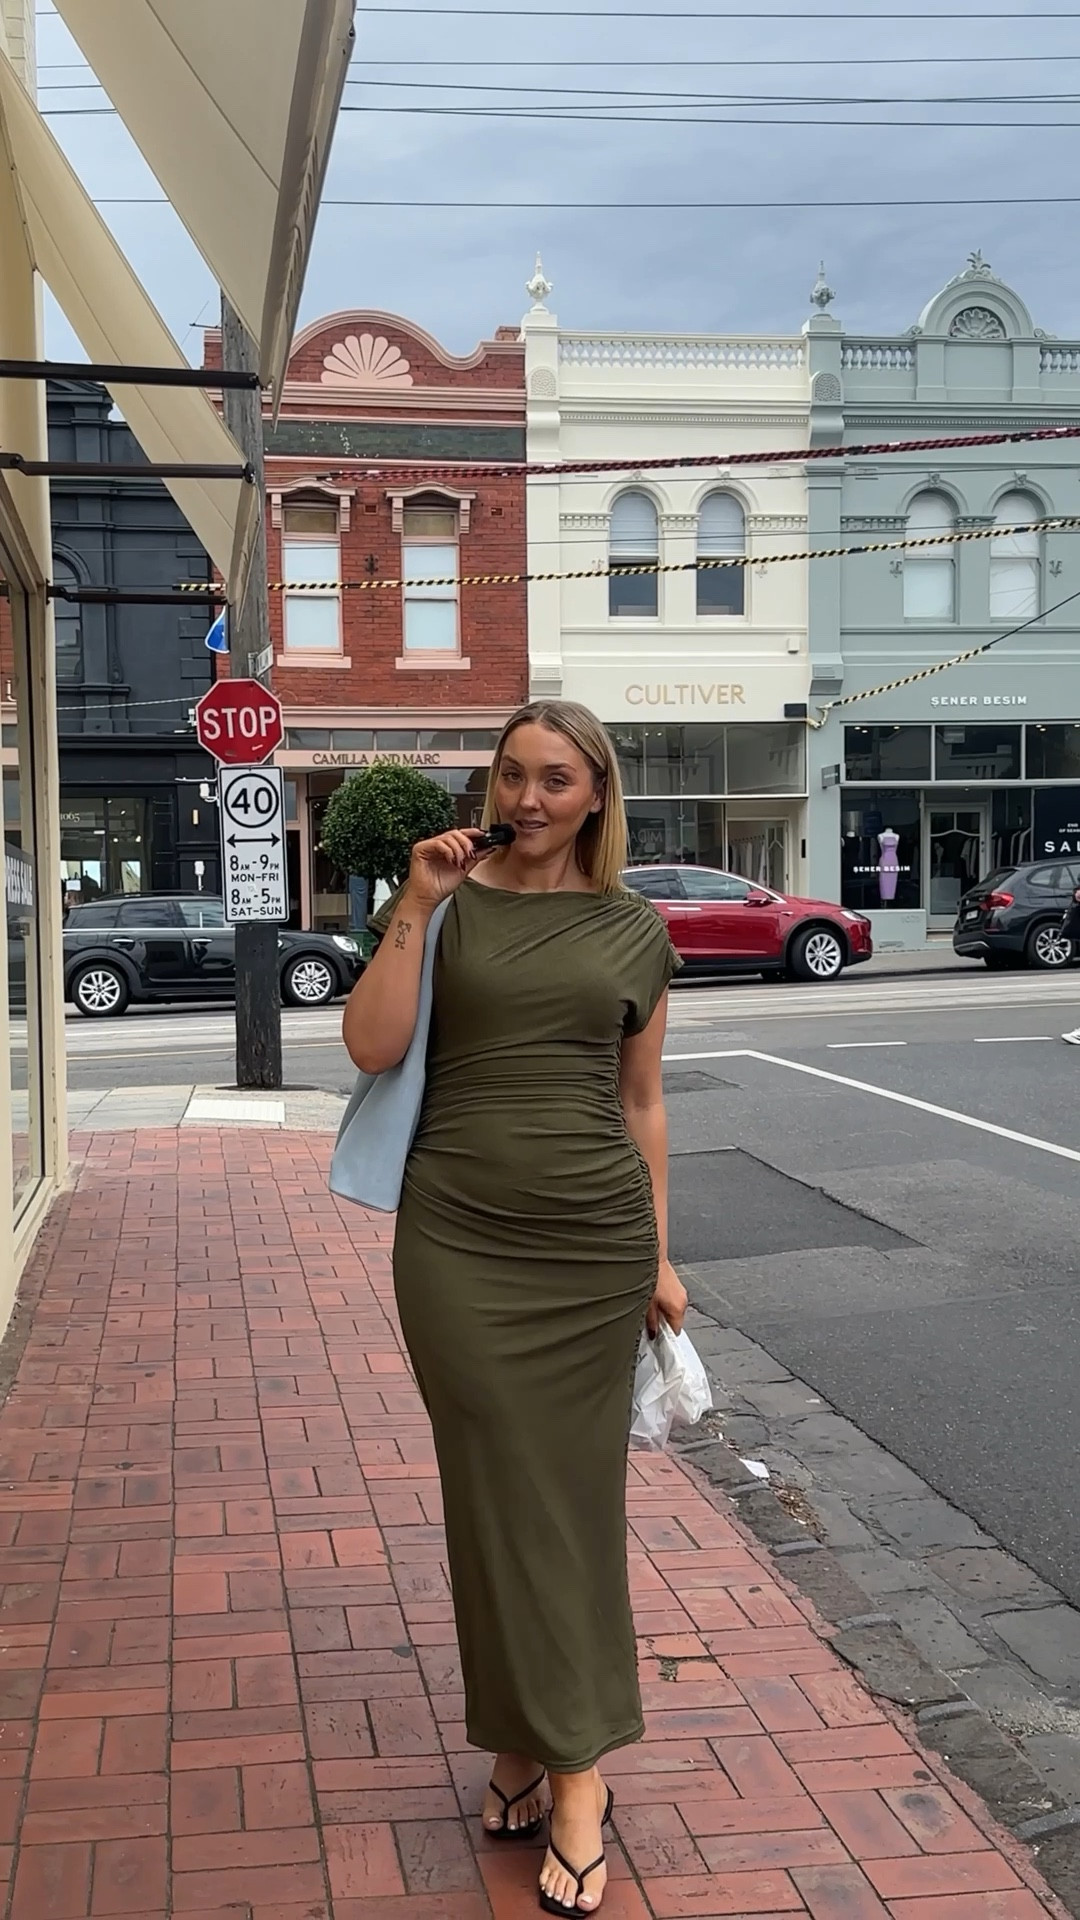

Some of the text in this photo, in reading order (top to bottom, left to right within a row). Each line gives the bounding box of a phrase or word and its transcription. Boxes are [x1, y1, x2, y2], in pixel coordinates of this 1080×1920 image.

[625, 683, 746, 705] CULTIVER
[983, 695, 1027, 706] BESIM
[203, 706, 277, 740] STOP
[312, 753, 440, 765] CAMILLA AND MARC
[230, 786, 273, 815] 40
[231, 873, 279, 882] MON-FRI
[231, 906, 283, 916] SAT-SUN
